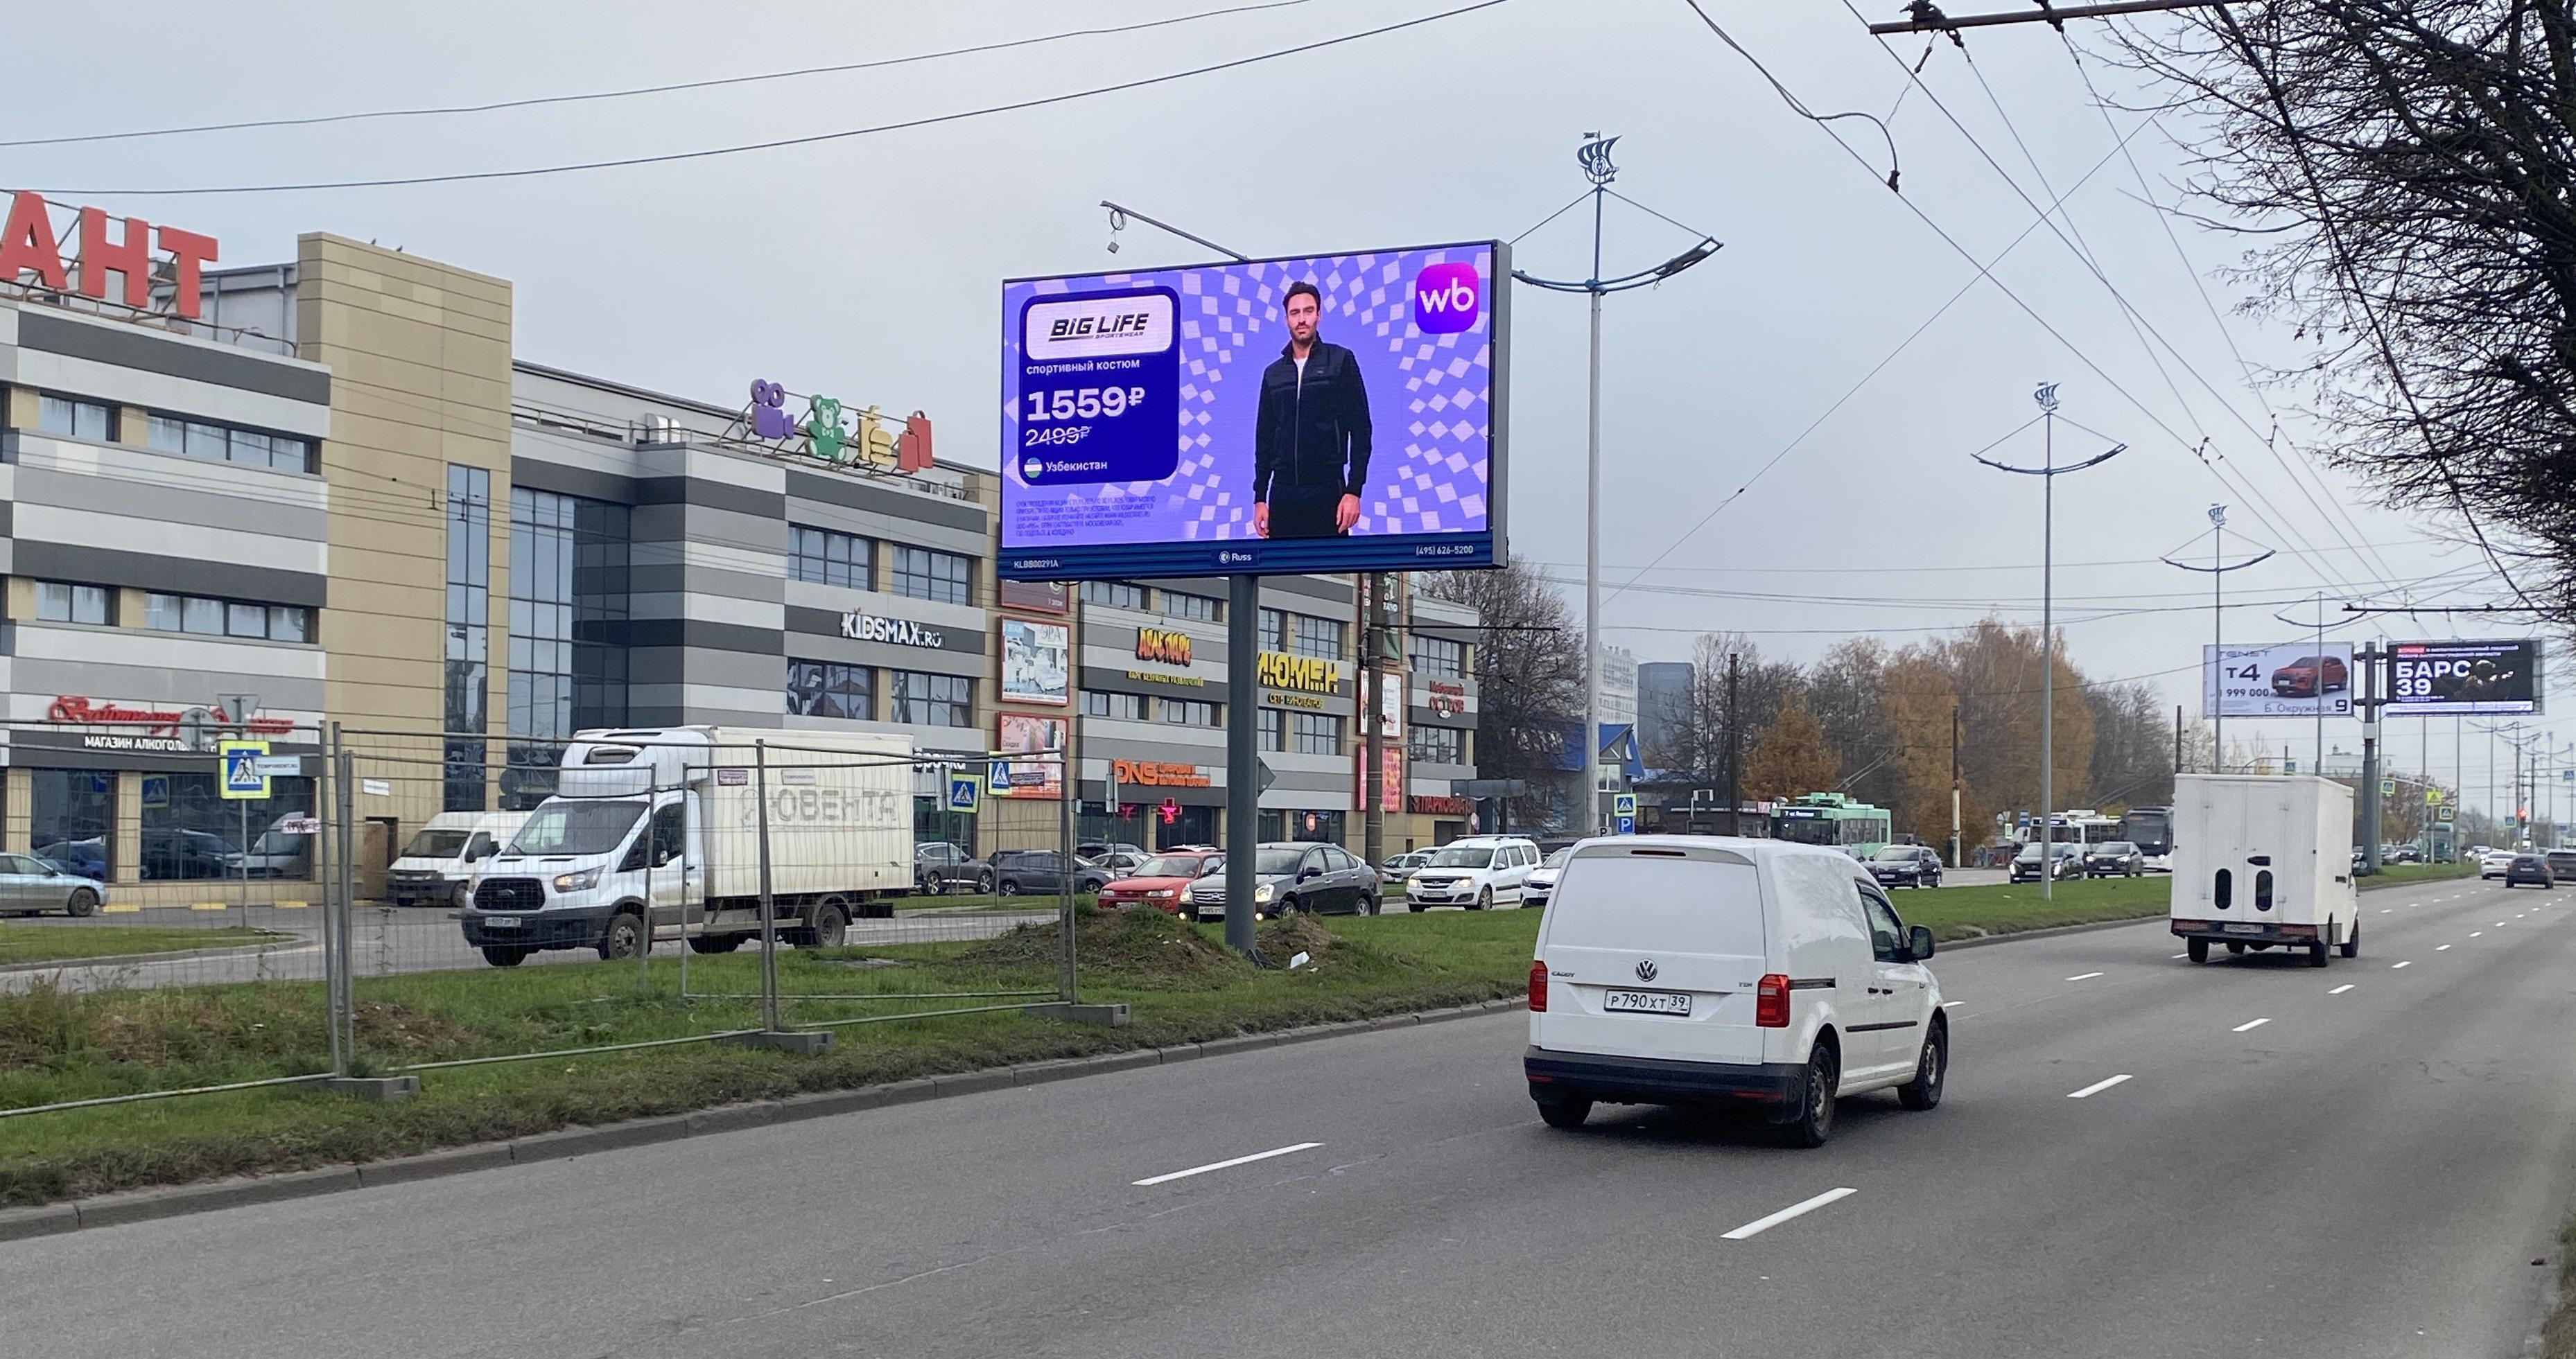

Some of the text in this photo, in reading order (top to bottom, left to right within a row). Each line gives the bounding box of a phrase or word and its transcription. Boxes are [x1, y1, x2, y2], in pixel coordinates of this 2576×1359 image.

[1419, 277, 1474, 313] wb
[1027, 360, 1140, 376] спортивный костюм
[1045, 460, 1108, 472] Узбекистан
[1231, 552, 1252, 561] Russ
[1416, 545, 1474, 556] (495) 626-5200
[1041, 625, 1062, 642] ЭРА
[2396, 660, 2472, 678] БАРС
[2227, 689, 2246, 697] 999
[2250, 688, 2269, 696] 000
[2396, 678, 2432, 696] 39
[2335, 699, 2347, 712] 9
[85, 736, 190, 751] МАГАЗИН АЛКОГОЛЬ
[1113, 760, 1158, 786] DNS
[1671, 996, 1686, 1007] 39
